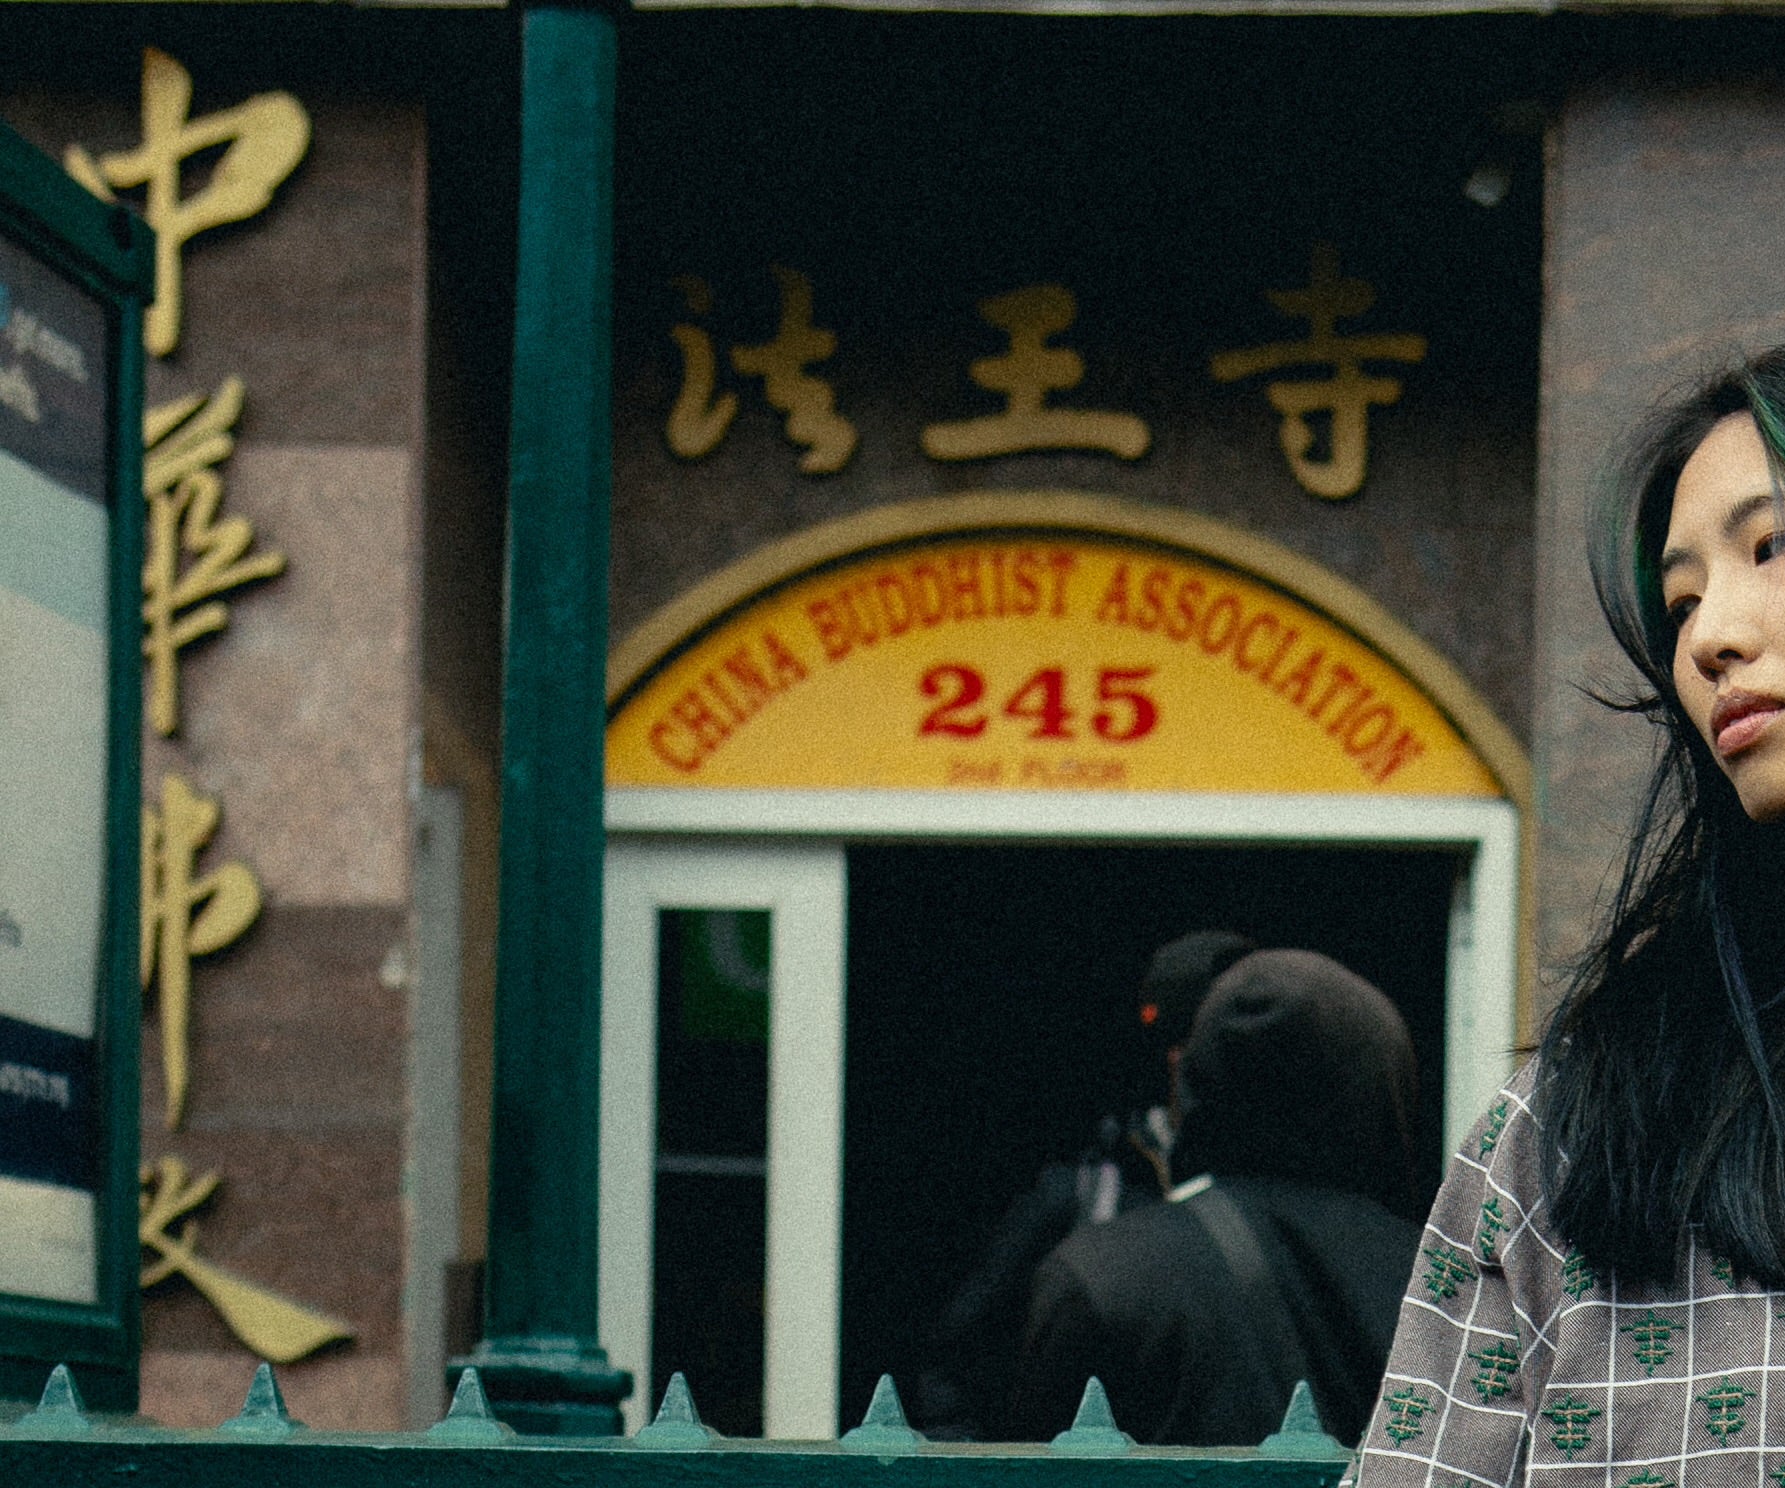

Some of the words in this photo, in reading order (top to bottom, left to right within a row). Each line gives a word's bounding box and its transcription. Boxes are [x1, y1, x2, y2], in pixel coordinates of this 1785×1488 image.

[650, 630, 810, 777] CHINA
[806, 549, 1074, 663] BUDDHIST
[1096, 563, 1427, 785] ASSOCIATION
[917, 662, 1160, 744] 245
